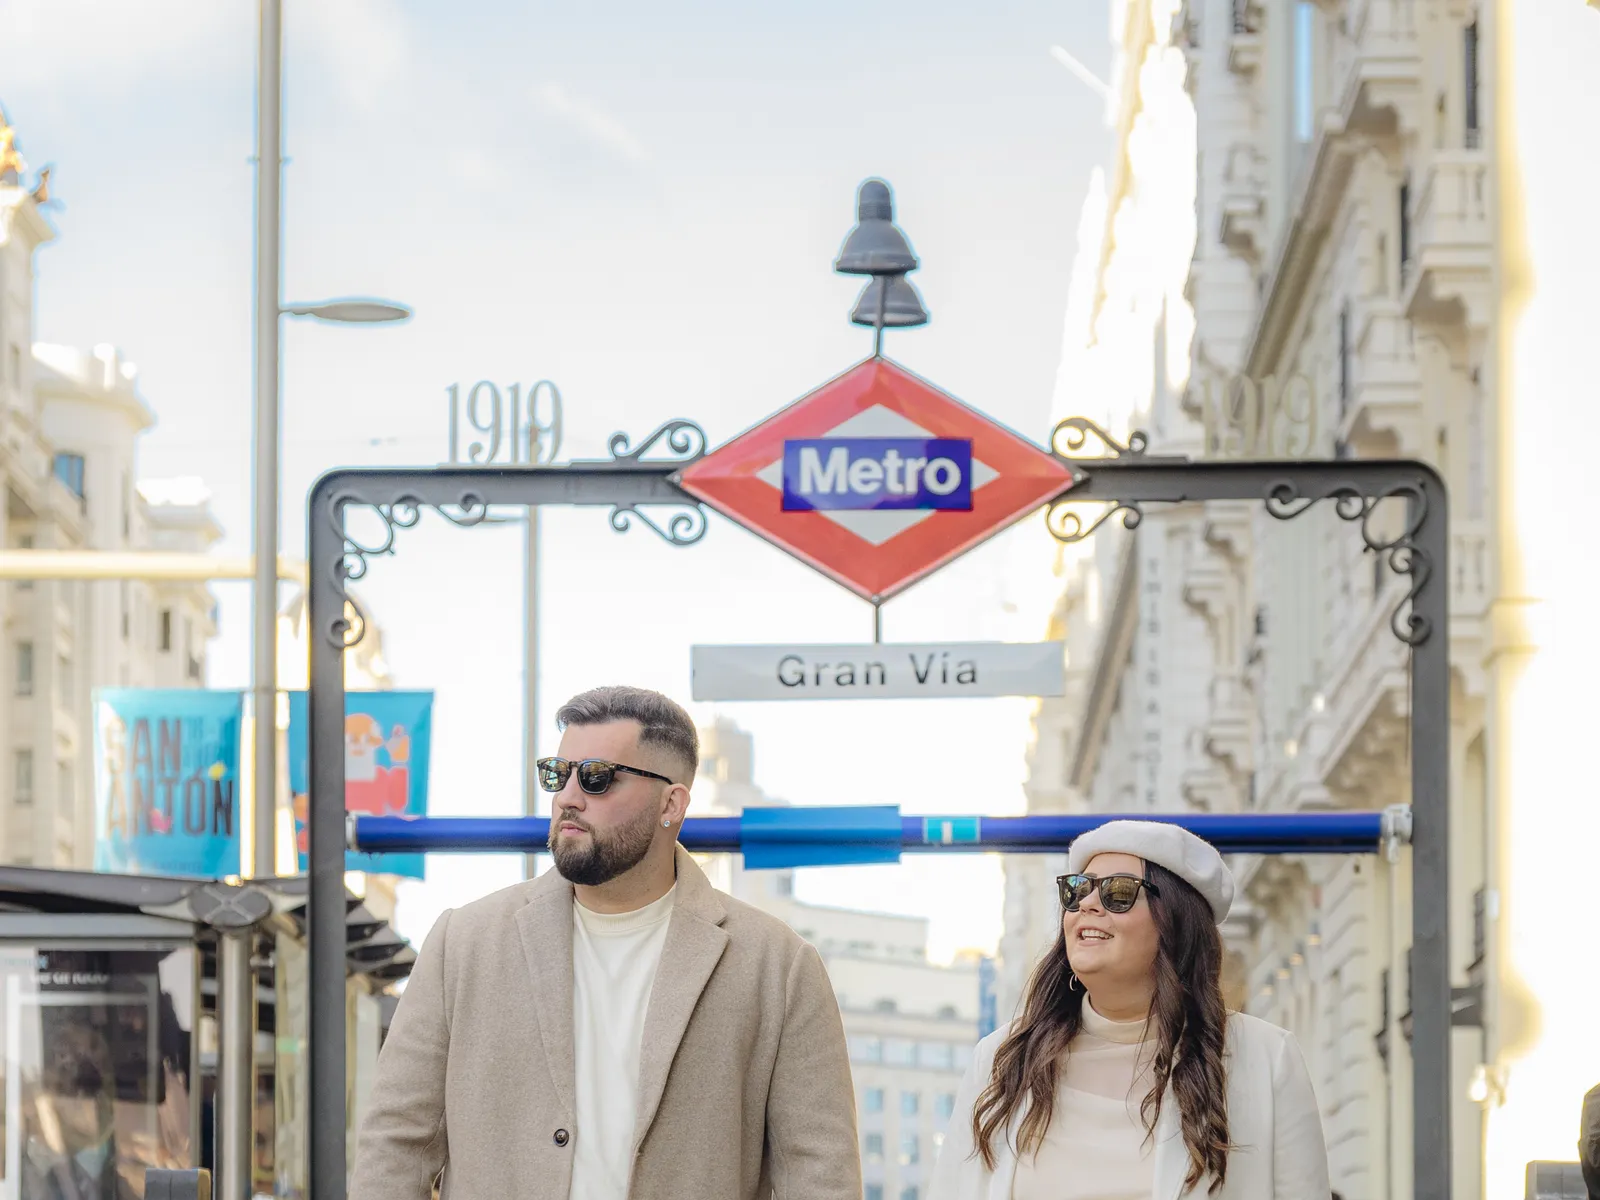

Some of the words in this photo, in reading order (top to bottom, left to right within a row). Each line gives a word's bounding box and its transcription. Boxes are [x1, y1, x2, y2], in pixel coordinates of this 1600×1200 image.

[445, 378, 565, 466] 1919
[797, 445, 962, 497] Metro
[776, 654, 887, 689] Gran
[908, 651, 979, 687] Vía
[105, 715, 182, 776] SAN
[106, 766, 234, 838] ANTÓN
